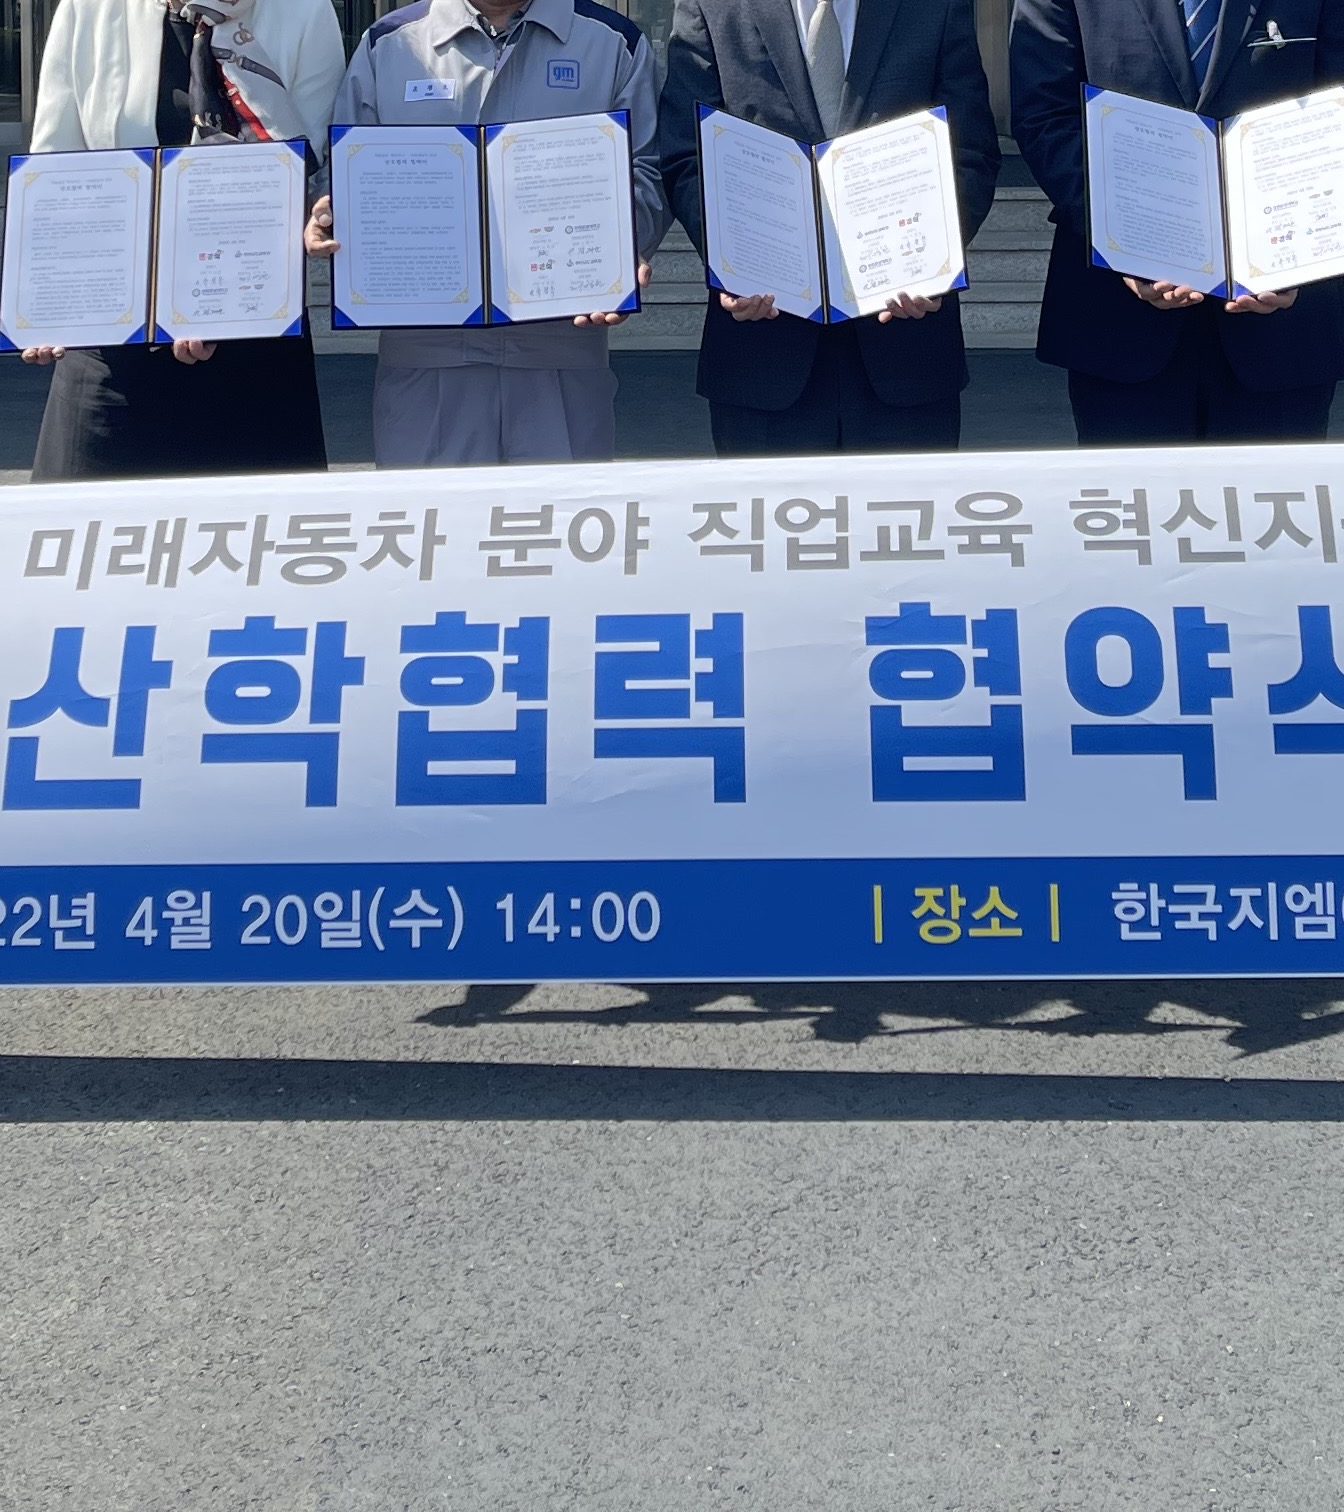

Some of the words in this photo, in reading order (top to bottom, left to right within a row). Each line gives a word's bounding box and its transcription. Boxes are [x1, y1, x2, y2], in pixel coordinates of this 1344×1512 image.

[23, 507, 447, 590] 미래자동차
[478, 501, 650, 578] 분야
[687, 490, 1033, 573] 직업교육
[1, 610, 747, 810] 산학협력
[125, 889, 212, 949] 4월
[240, 886, 464, 951] 20일(수)
[495, 890, 661, 943] 14:00
